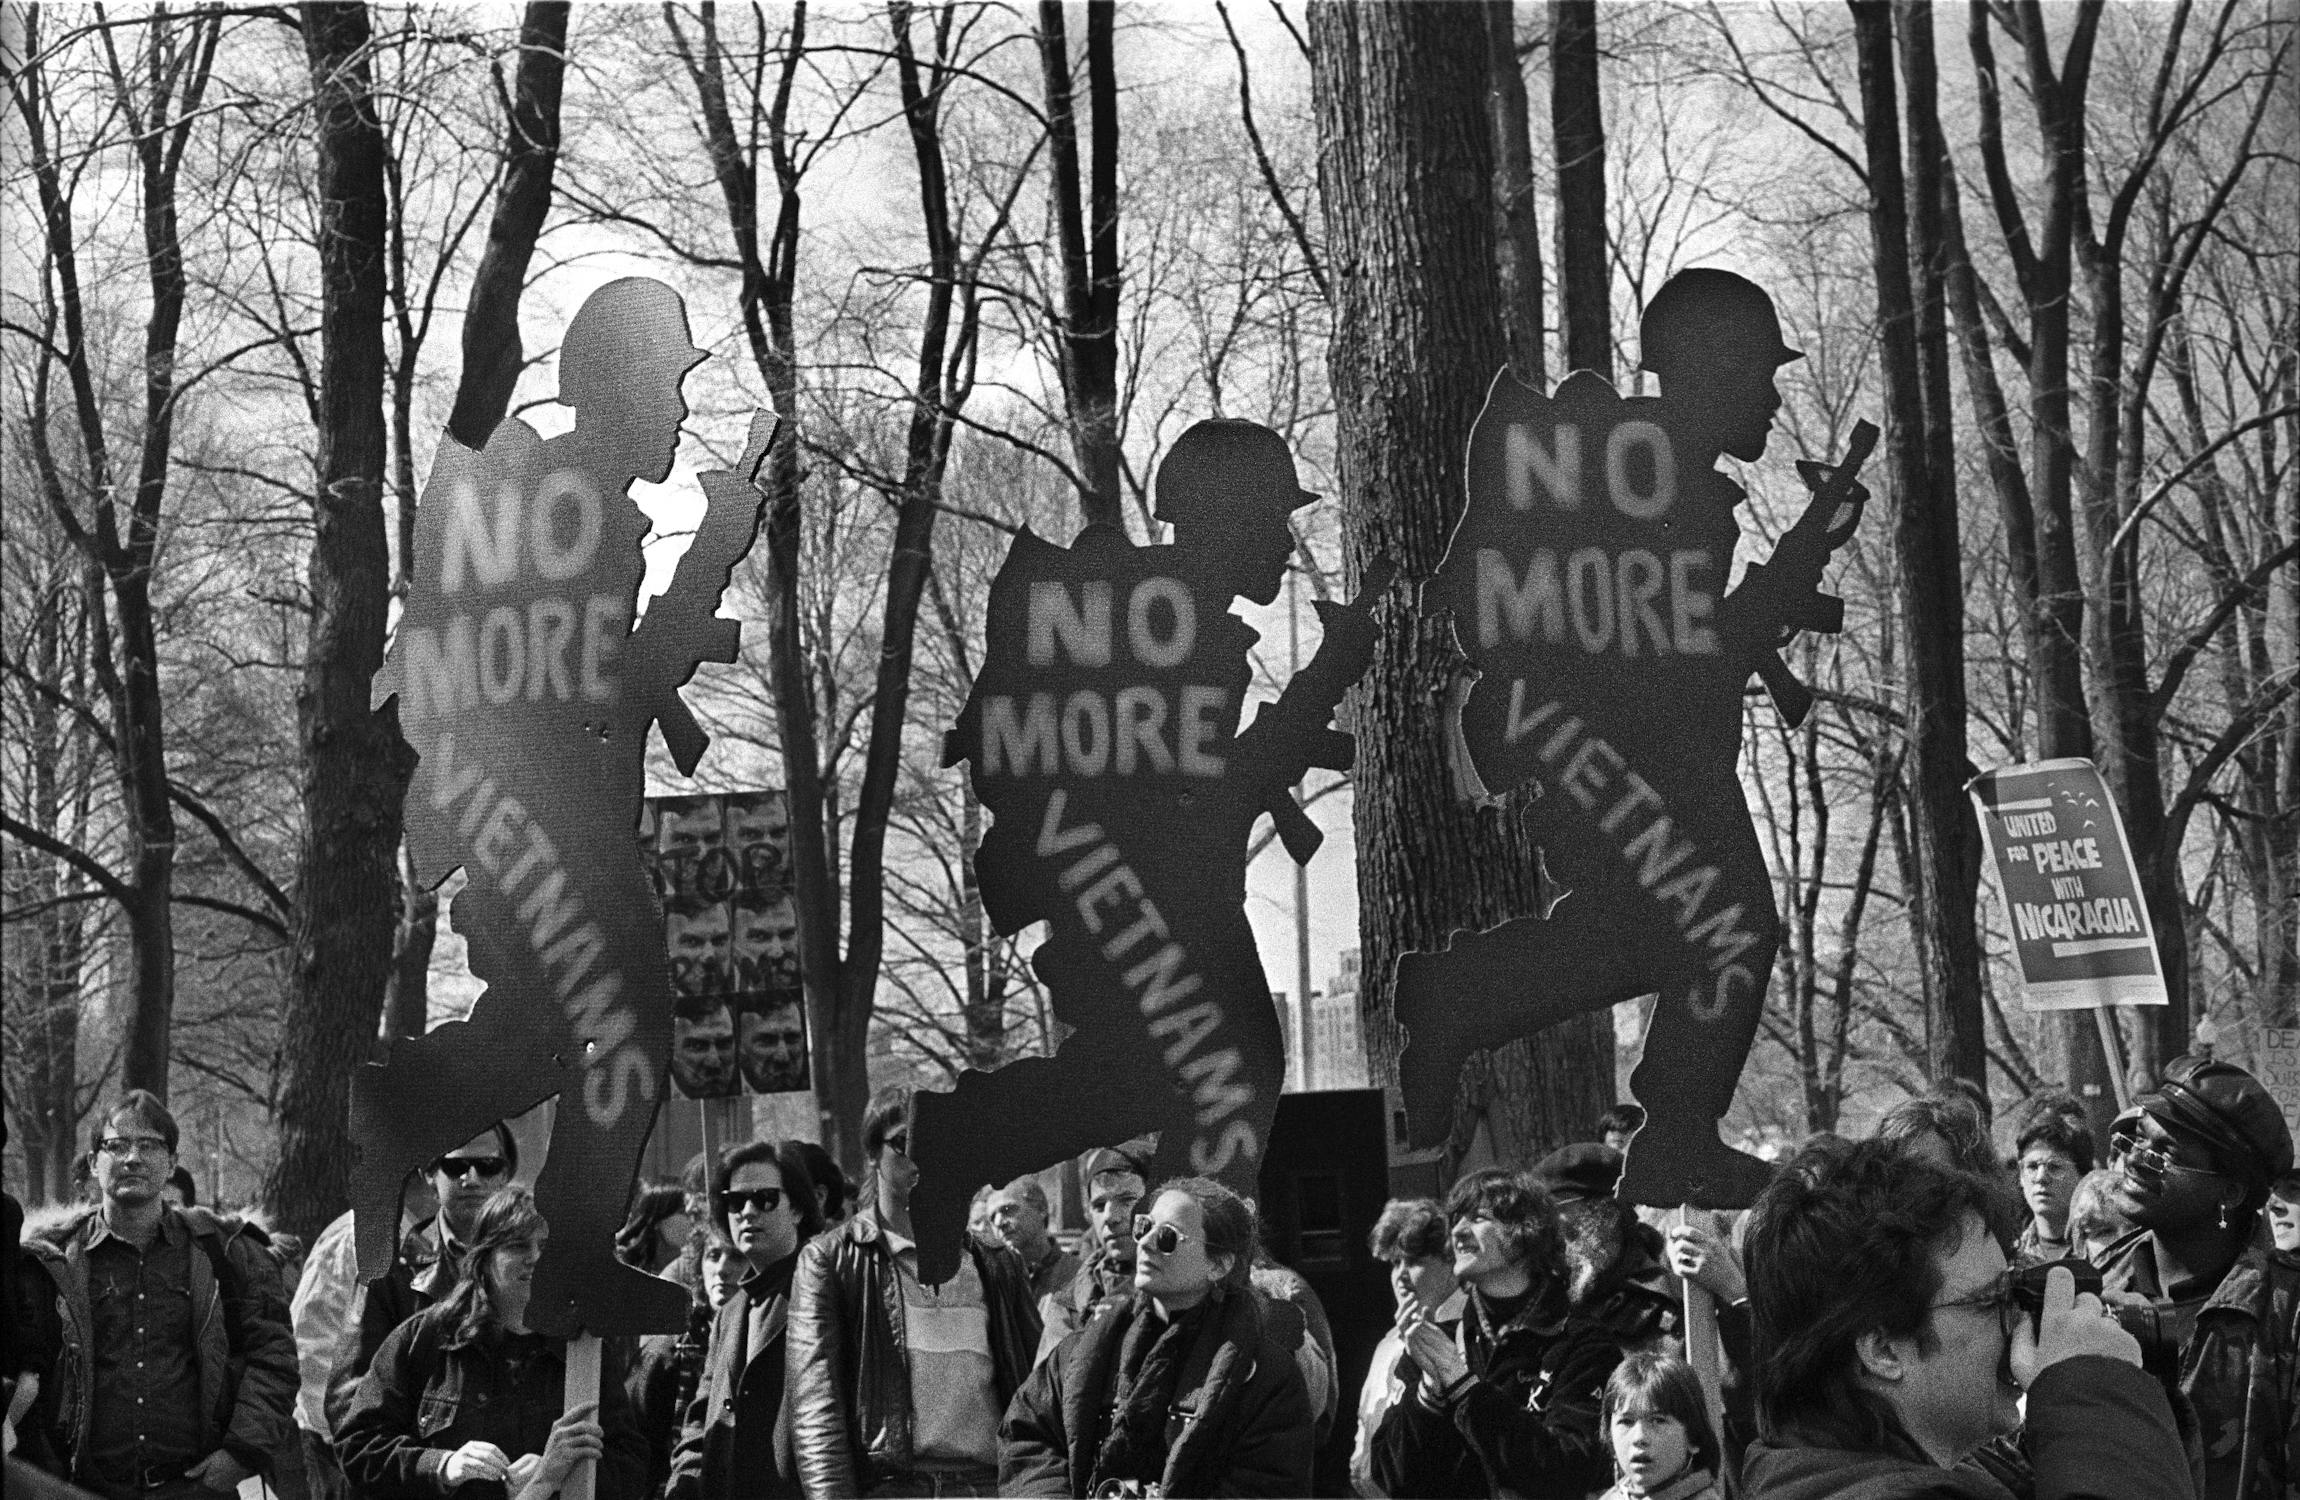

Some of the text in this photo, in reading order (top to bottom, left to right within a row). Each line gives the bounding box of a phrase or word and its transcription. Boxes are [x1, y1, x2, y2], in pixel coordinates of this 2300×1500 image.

[1505, 420, 1676, 519] NO
[442, 466, 602, 592] NO
[1027, 576, 1197, 668] NO
[1476, 548, 1718, 655] MORE
[402, 596, 627, 712] MORE
[981, 686, 1229, 777] MORE
[1504, 678, 1760, 1023] VIETNAMS
[2003, 810, 2058, 838] UNITED
[2006, 837, 2103, 874] FOR PEACE
[430, 732, 655, 1130] VIETNAMS
[2014, 897, 2140, 941] NICARAGUA
[2050, 875, 2085, 900] WITH
[1036, 788, 1259, 1178] VIETNAMS
